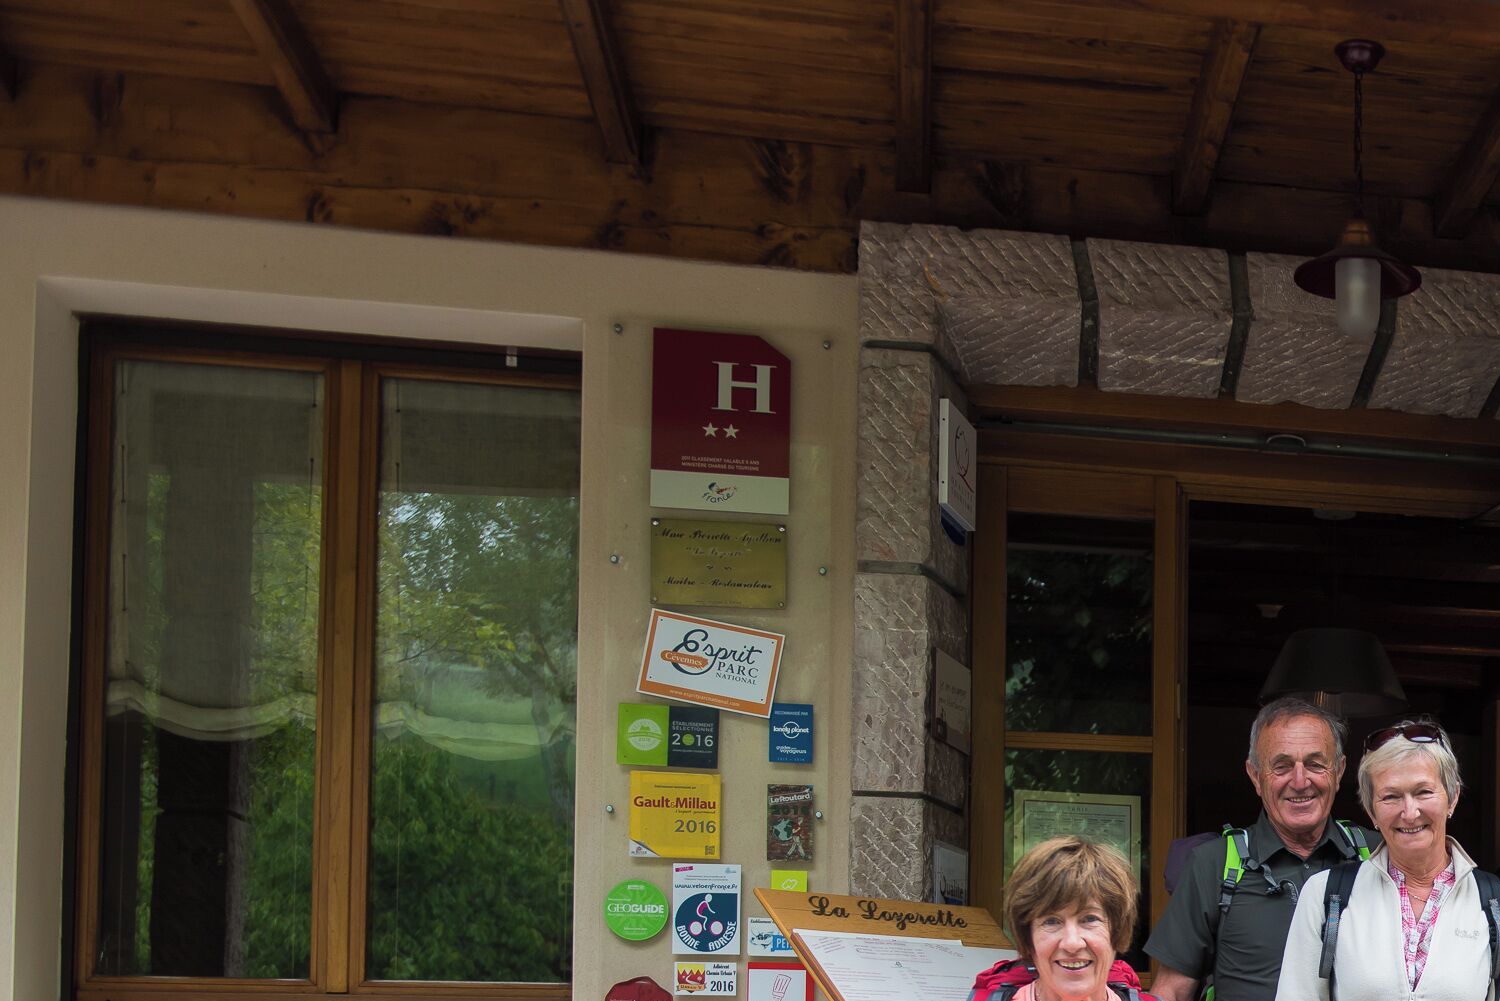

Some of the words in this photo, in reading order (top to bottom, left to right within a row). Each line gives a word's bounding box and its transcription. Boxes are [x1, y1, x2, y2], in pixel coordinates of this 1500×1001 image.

[712, 360, 777, 414] H
[665, 652, 703, 666] Cévennes
[671, 629, 762, 675] Esprit
[718, 661, 759, 678] PARC
[715, 673, 757, 685] NATIONAL
[773, 725, 791, 735] lonely
[791, 726, 810, 735] planet
[674, 819, 717, 833] 2016
[808, 895, 850, 918] La
[857, 900, 968, 930] Lozerette
[677, 924, 701, 950] BONNE
[708, 920, 737, 951] ADRESSE
[710, 981, 734, 992] 2016
